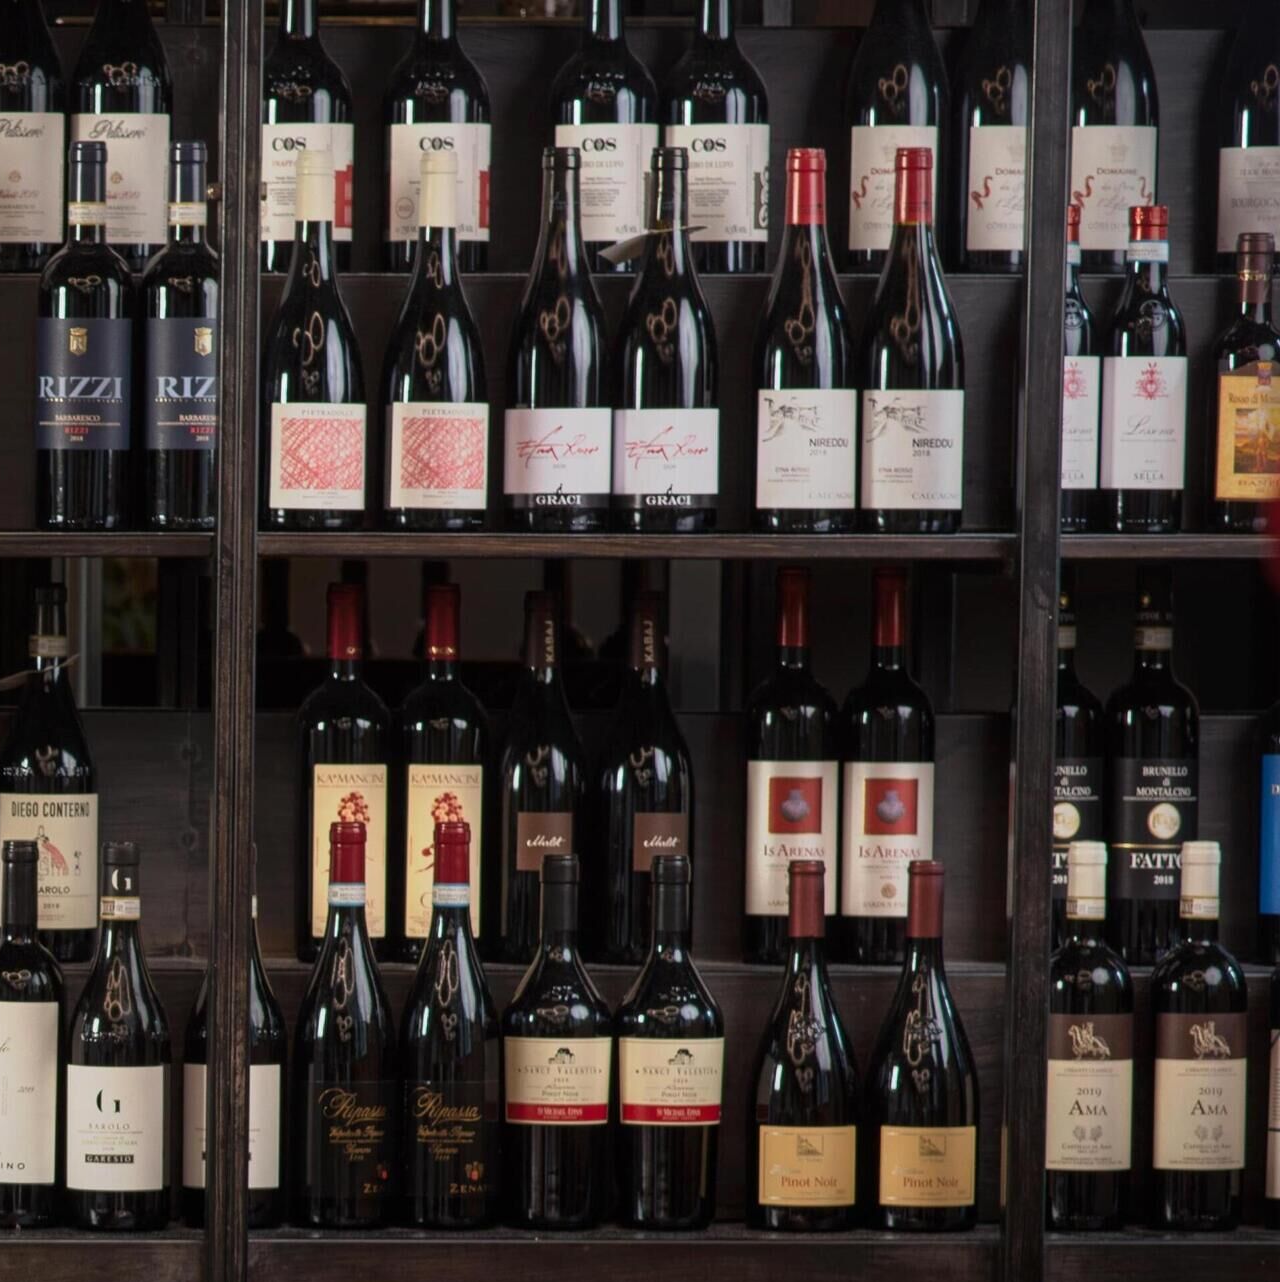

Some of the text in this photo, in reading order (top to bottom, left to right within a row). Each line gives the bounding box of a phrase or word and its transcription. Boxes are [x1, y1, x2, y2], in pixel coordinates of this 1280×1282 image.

[271, 136, 307, 153] COS
[419, 136, 455, 153] COS
[581, 137, 617, 153] COS
[690, 137, 727, 153] COS
[40, 376, 123, 398] RIZZI
[156, 376, 216, 398] RIZ
[809, 438, 849, 449] NIREDDU
[912, 438, 953, 449] NIREDDU
[535, 495, 582, 506] GRACI
[646, 495, 692, 506] GRACI
[1142, 766, 1188, 776] BRUNELLO
[1136, 787, 1191, 797] MONTALCINO
[11, 802, 90, 818] DIEGO CONTERNO
[39, 886, 71, 894] AROLO
[1076, 1087, 1102, 1097] 2019
[1198, 1086, 1224, 1097] 2019
[85, 1154, 134, 1163] GARESIO
[780, 1176, 838, 1188] Pinot Noir
[902, 1176, 959, 1188] Pinot Noir
